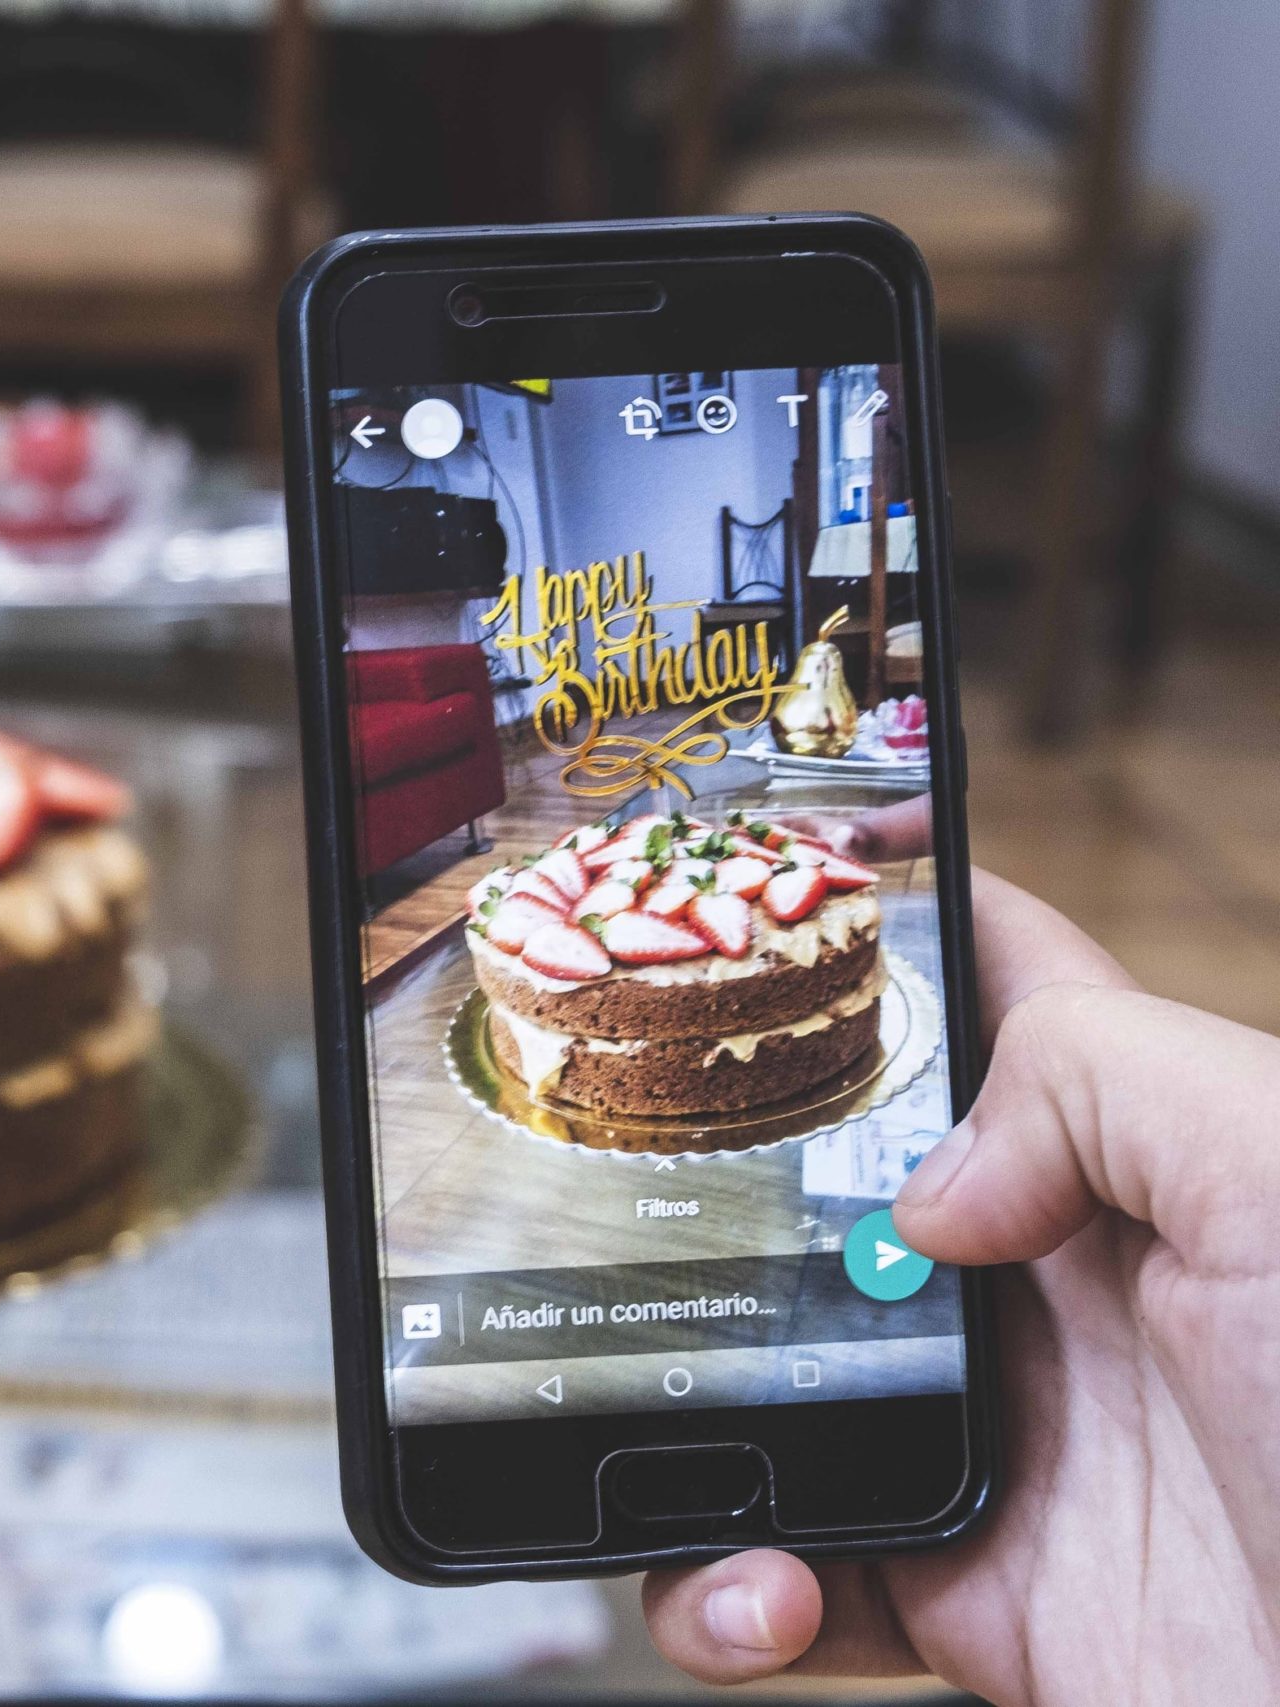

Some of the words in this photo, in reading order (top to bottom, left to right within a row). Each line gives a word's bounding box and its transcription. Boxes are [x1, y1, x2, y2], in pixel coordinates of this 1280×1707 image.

[480, 551, 658, 672] Happy
[532, 612, 788, 760] Birthday
[636, 1197, 700, 1219] Filtros
[481, 1302, 565, 1331] Añadir
[570, 1304, 604, 1326] un
